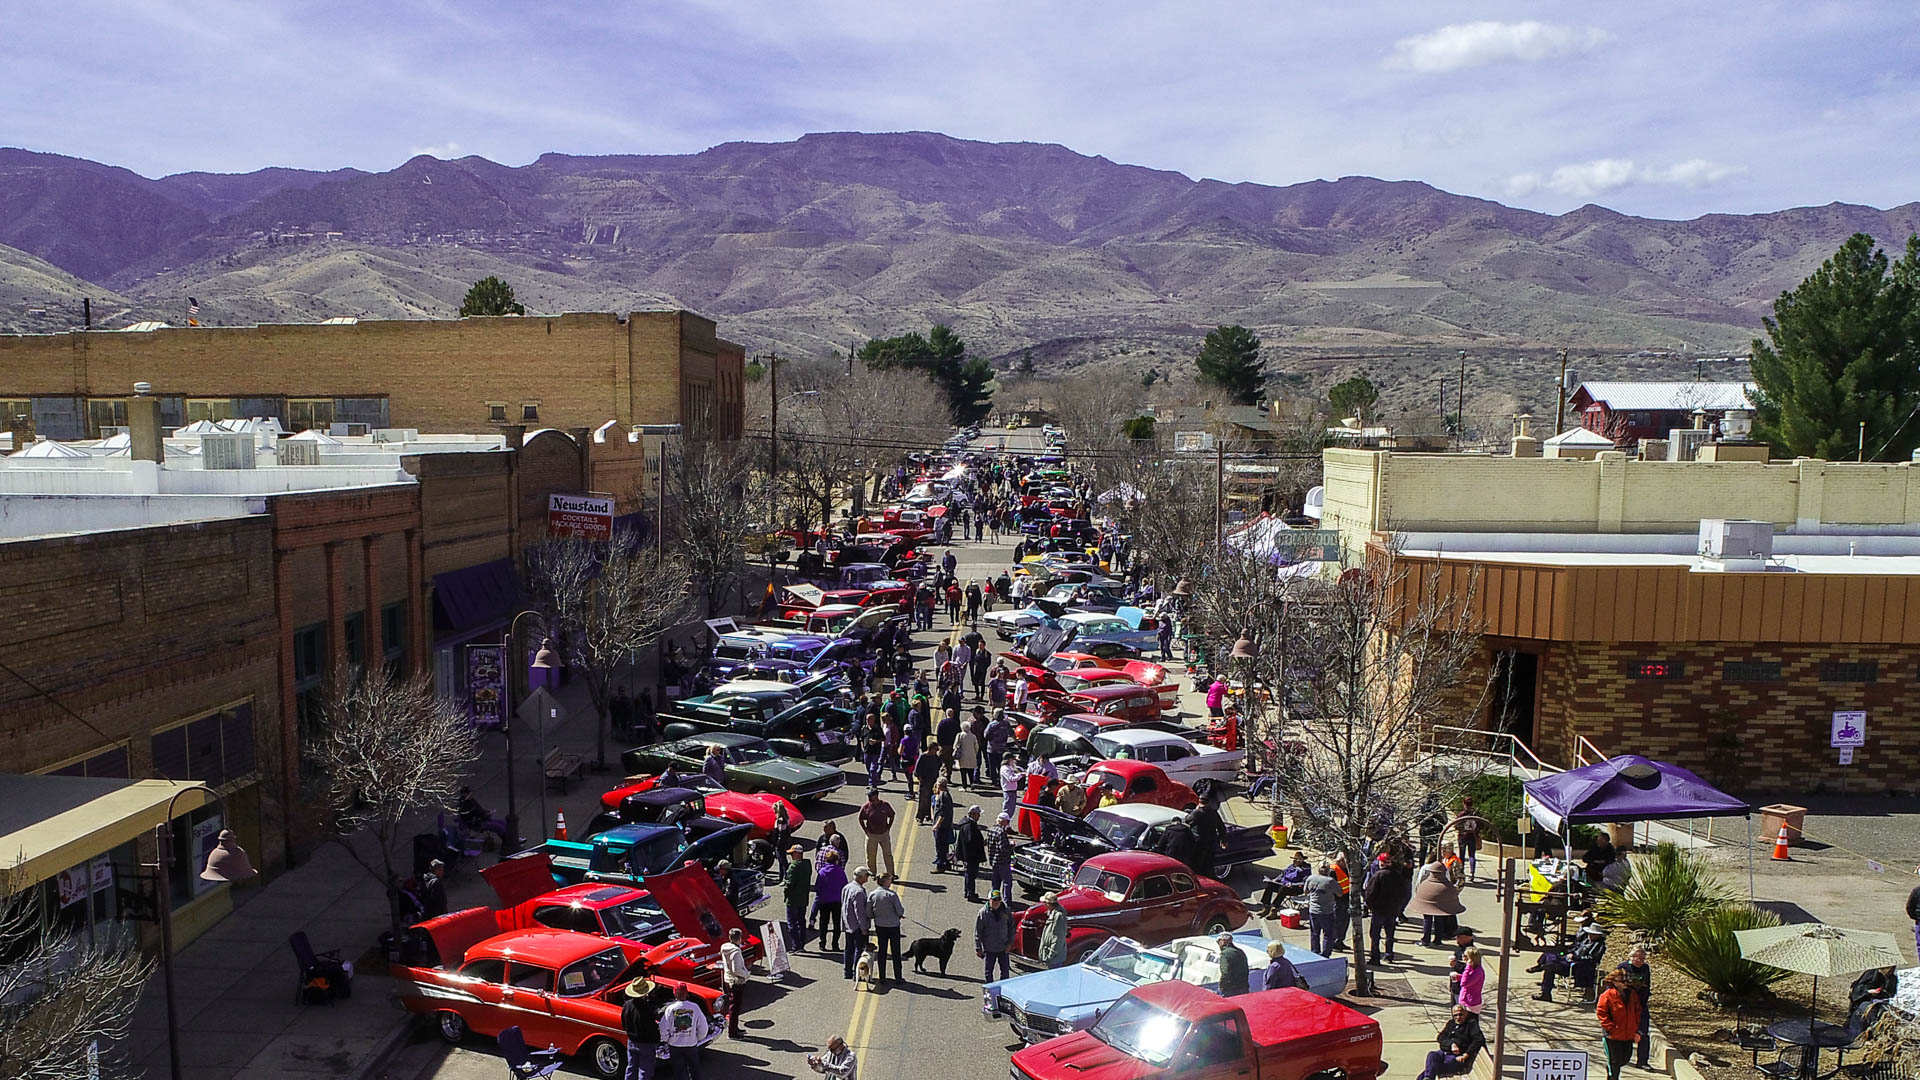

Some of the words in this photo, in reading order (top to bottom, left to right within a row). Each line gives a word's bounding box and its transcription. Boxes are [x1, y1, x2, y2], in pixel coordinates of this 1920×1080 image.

[553, 497, 609, 513] Newstand
[562, 514, 598, 523] COCKTAILS
[551, 519, 582, 529] PACKAGE
[583, 523, 607, 531] GOODS
[1531, 1058, 1582, 1071] SPEED
